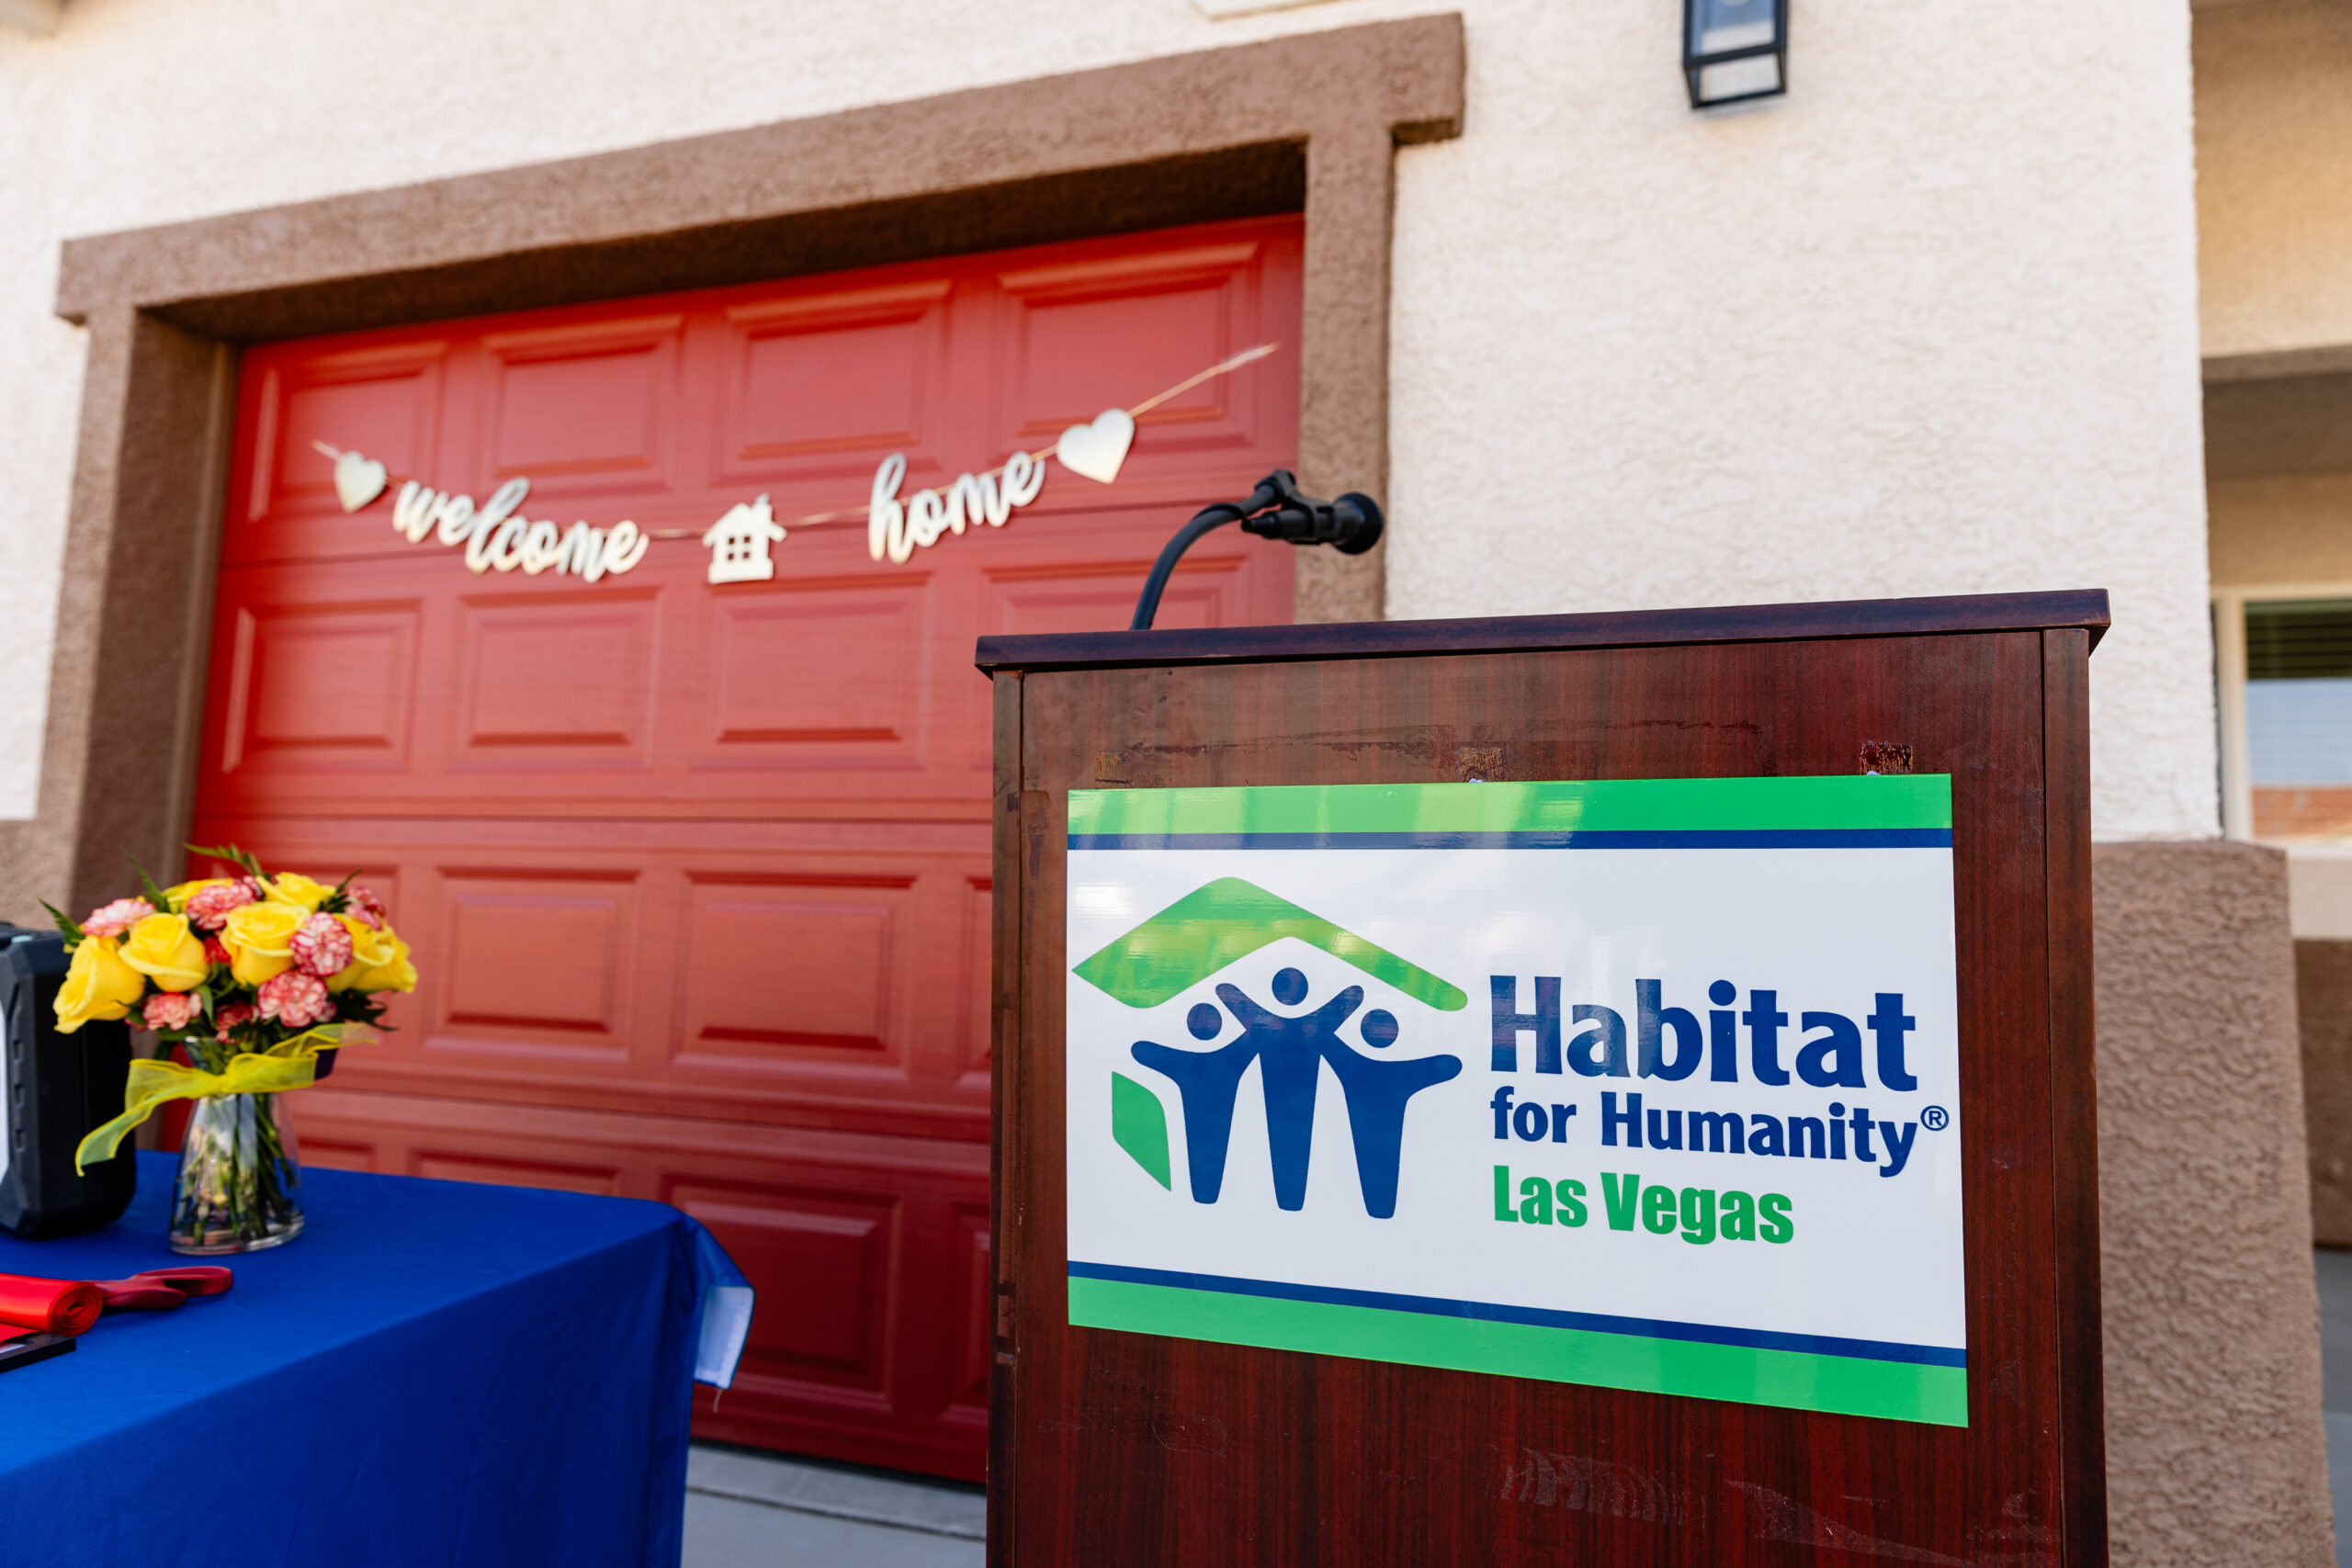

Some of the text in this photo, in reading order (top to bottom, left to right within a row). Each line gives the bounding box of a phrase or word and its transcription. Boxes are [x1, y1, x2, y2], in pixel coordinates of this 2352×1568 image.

[391, 452, 1046, 582] welcome home
[1489, 975, 1918, 1092] Habitat
[1489, 1085, 1577, 1144] for
[1493, 1165, 1795, 1246] Las Vegas
